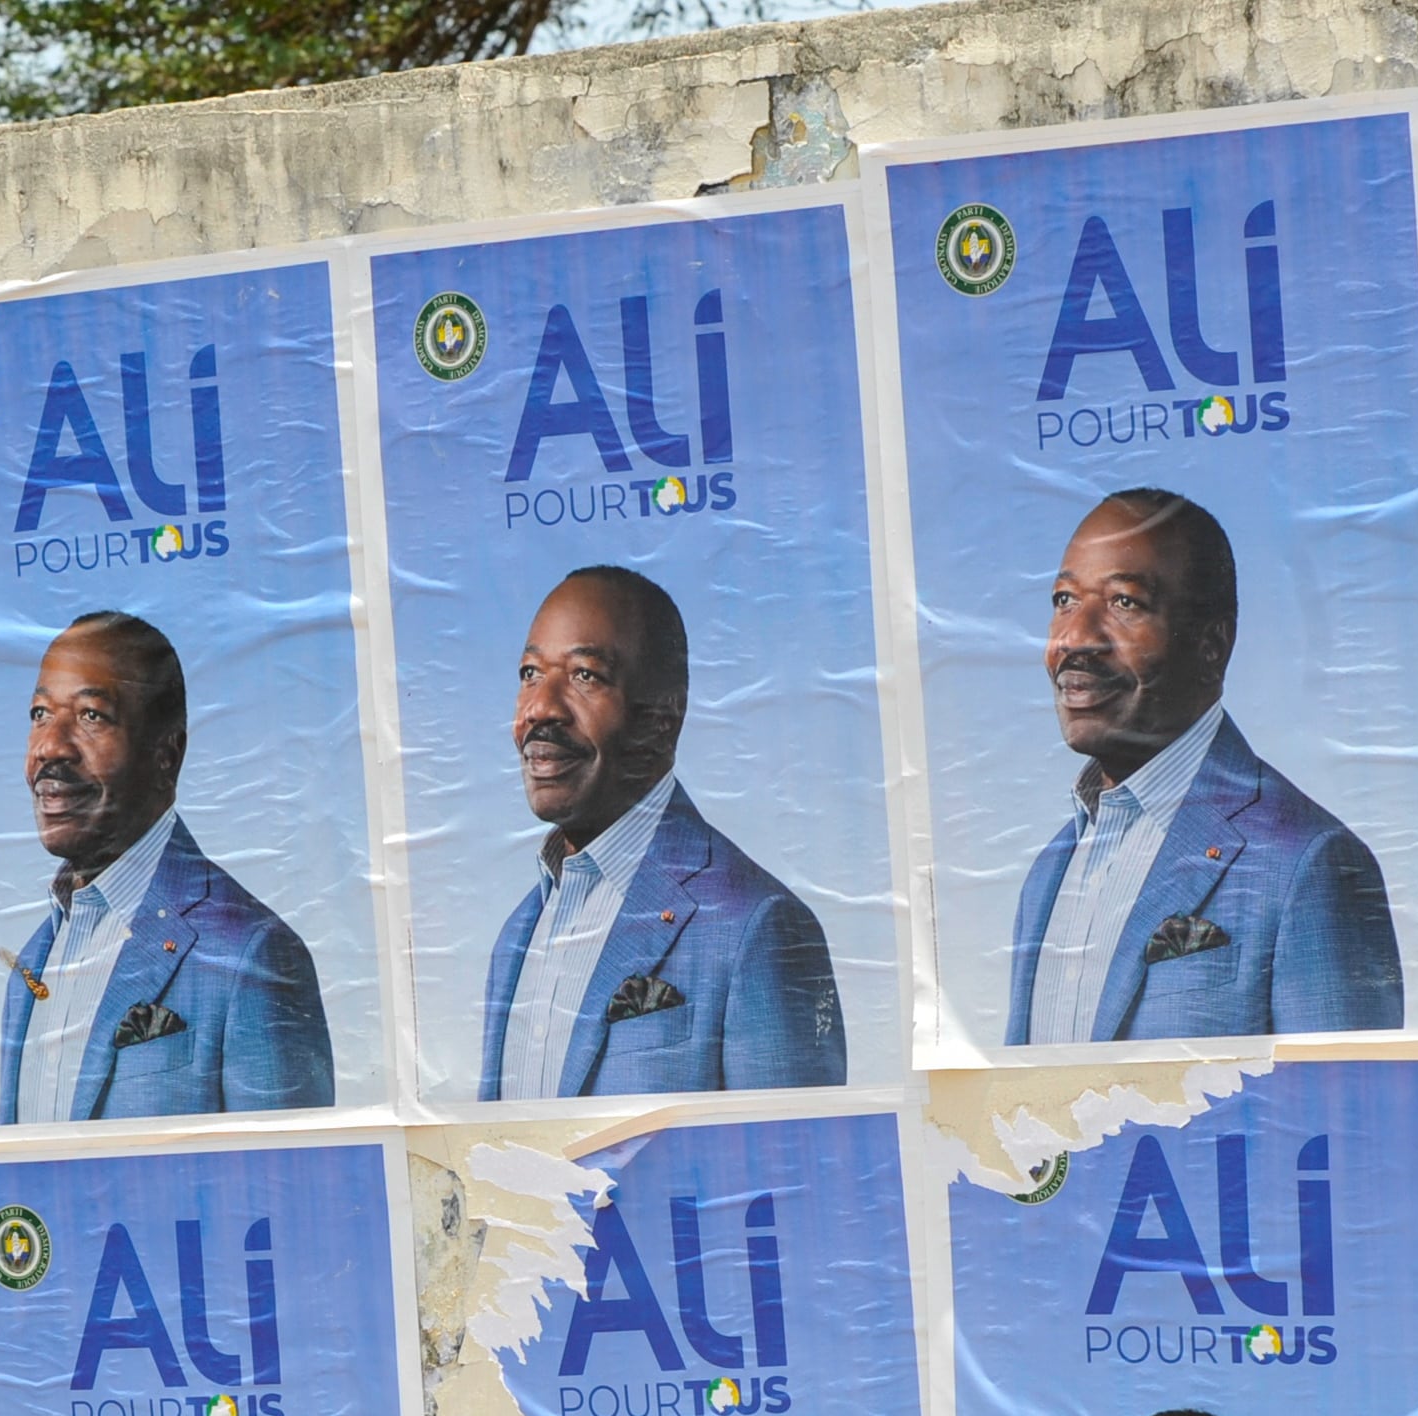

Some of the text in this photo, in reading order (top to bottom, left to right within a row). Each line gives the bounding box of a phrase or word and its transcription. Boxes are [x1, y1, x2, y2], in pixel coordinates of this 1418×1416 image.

[956, 207, 983, 220] PARTI
[433, 296, 458, 308] PARTI
[0, 1208, 23, 1220] PARTI
